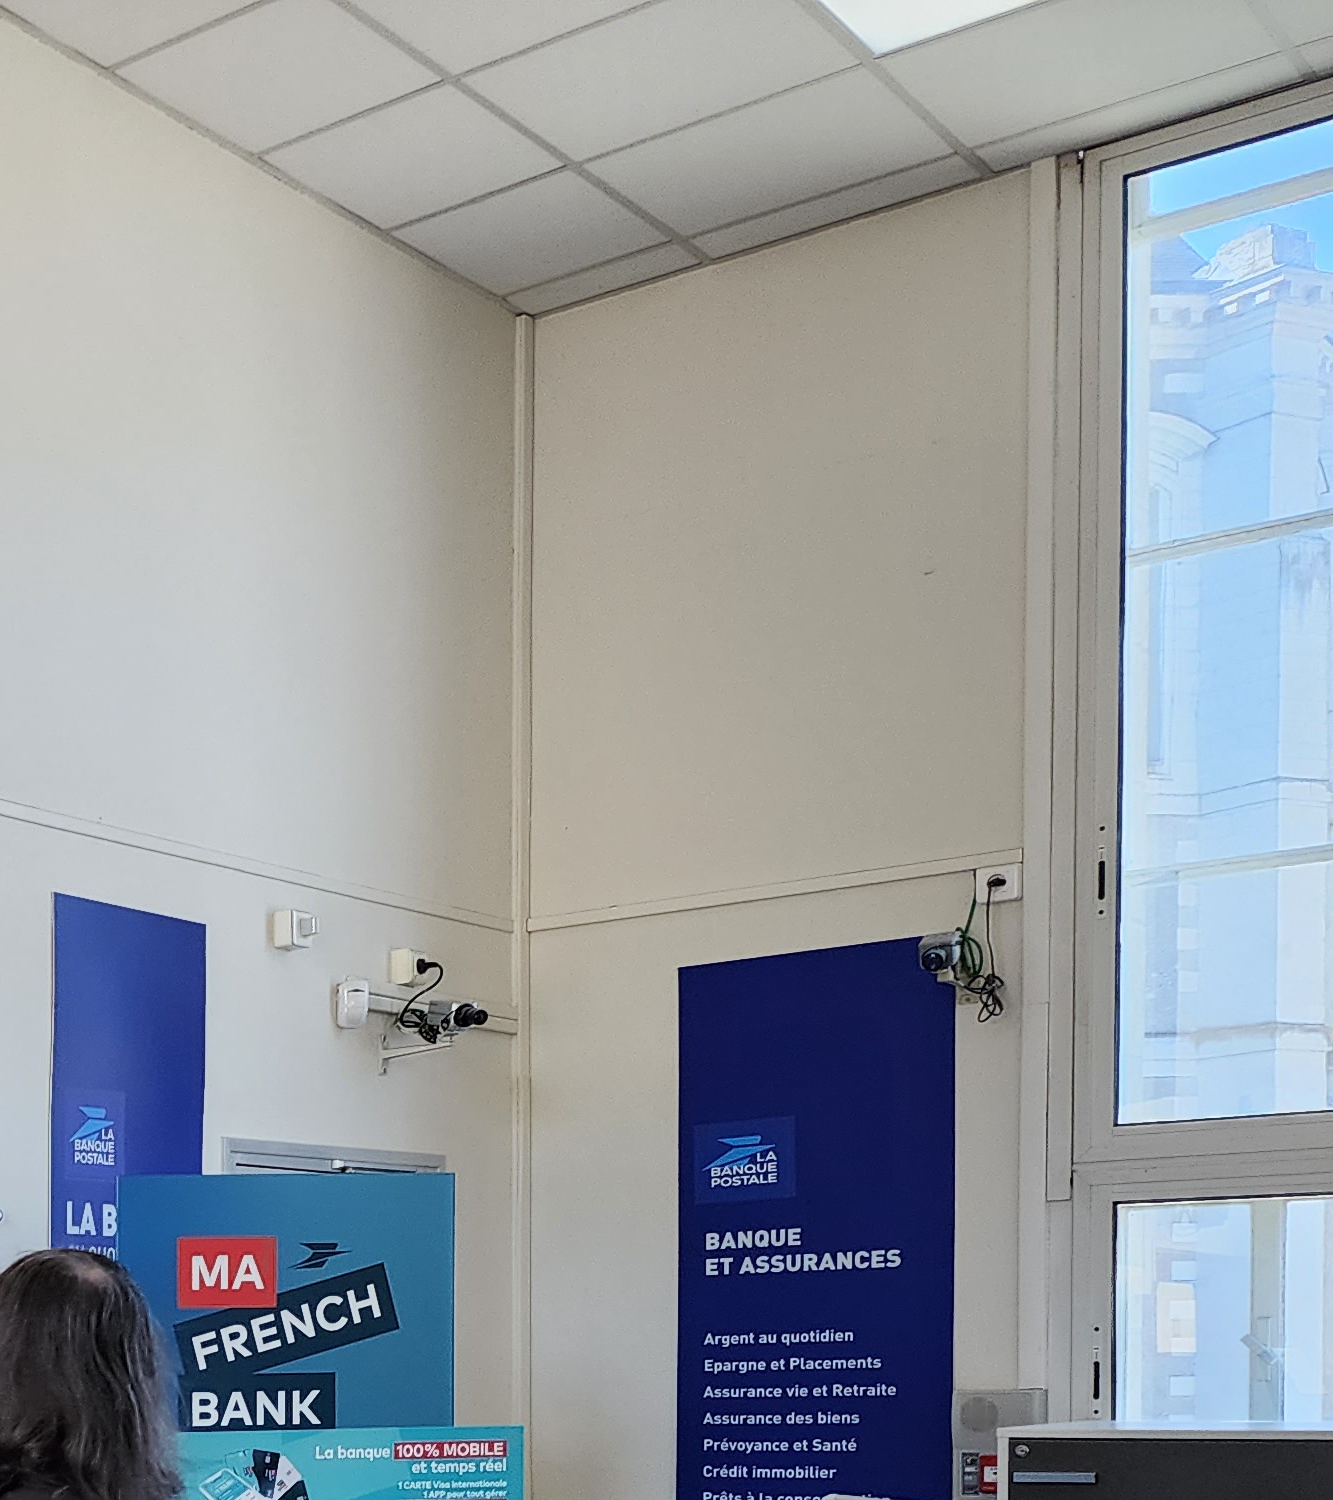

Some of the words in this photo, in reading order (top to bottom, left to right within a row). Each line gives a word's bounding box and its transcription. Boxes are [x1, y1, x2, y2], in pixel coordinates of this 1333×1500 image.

[704, 1227, 803, 1252] BANQUE
[191, 1253, 266, 1291] MA
[704, 1257, 734, 1276] ET
[738, 1249, 903, 1275] ASSURANCES
[191, 1282, 383, 1372] FRENCH
[703, 1331, 756, 1348] Argent
[758, 1333, 778, 1345] au
[780, 1329, 855, 1346] quotidien
[703, 1359, 767, 1375] Epargne
[770, 1358, 786, 1371] et
[789, 1356, 883, 1371] Placements
[191, 1388, 323, 1428] BANK
[703, 1437, 789, 1454] Prévoyance
[792, 1439, 809, 1452] et
[811, 1437, 858, 1452] Santé
[702, 1465, 749, 1479] Crédit
[751, 1465, 838, 1480] immobilier
